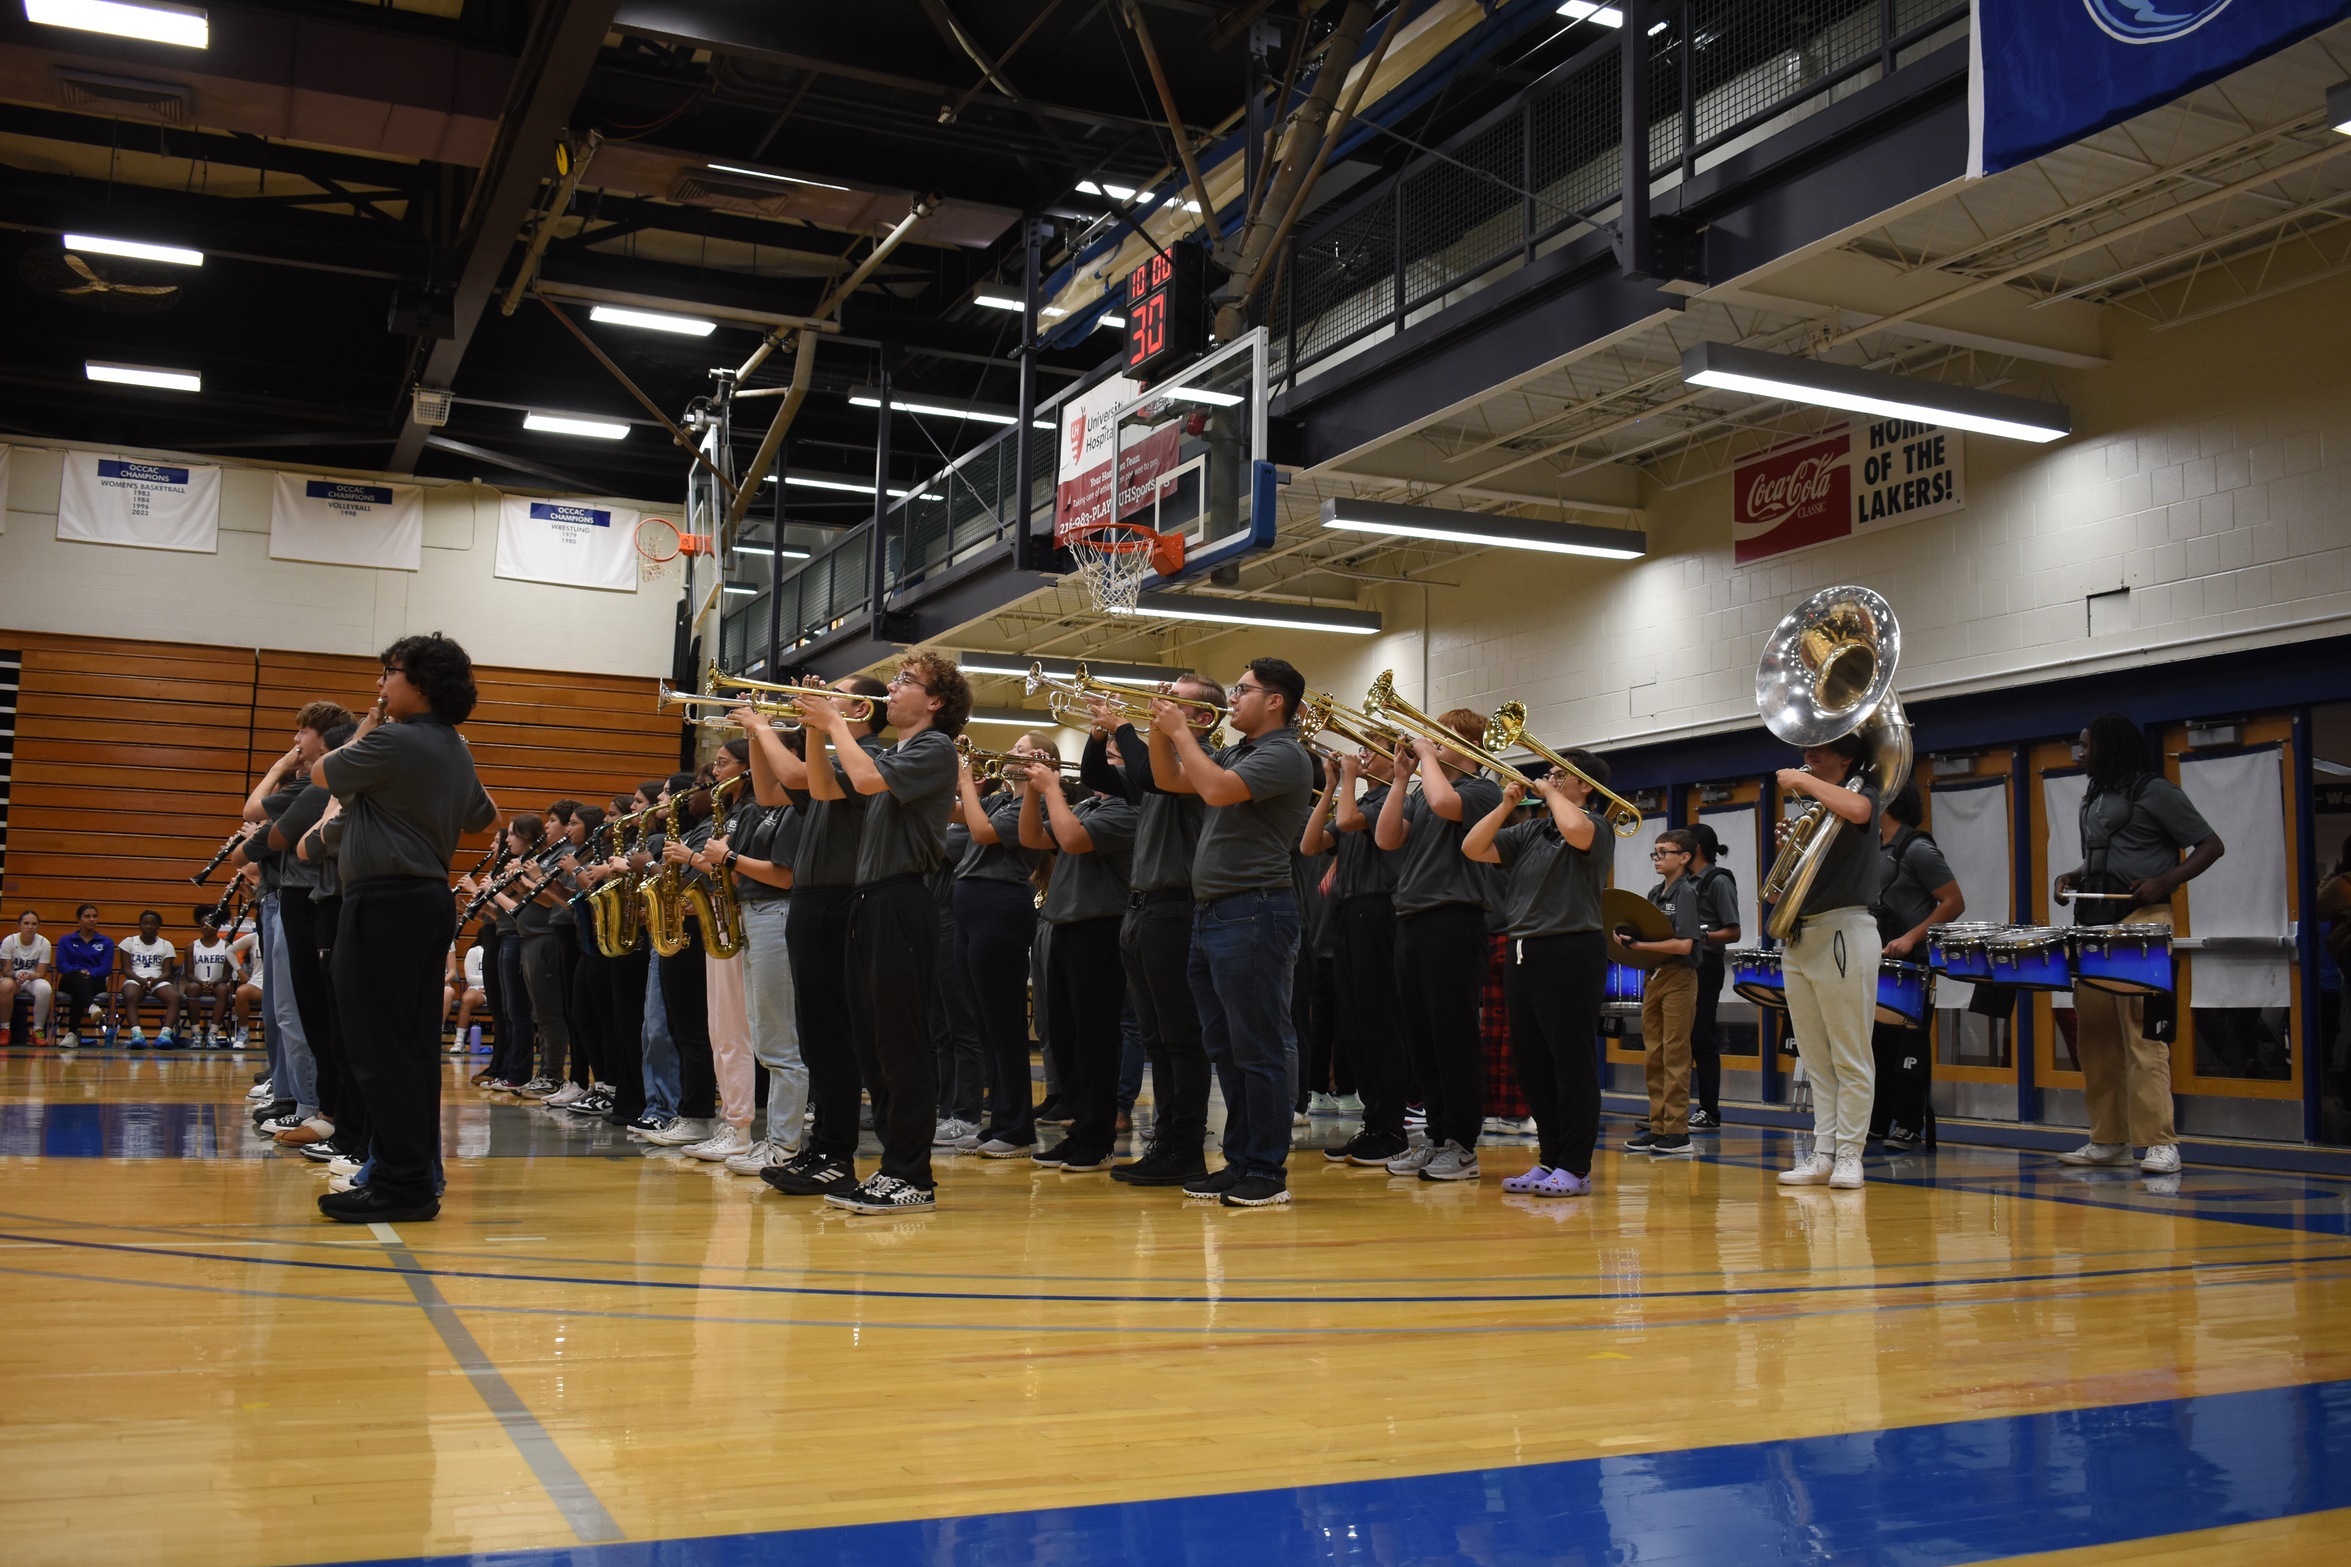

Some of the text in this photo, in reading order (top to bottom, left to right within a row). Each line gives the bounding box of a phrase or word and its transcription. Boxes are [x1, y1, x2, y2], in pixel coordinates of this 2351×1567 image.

[1130, 293, 1165, 366] 30
[1087, 400, 1123, 432] Universit
[1086, 427, 1114, 453] Hospita
[1143, 462, 1150, 471] to
[1863, 435, 1946, 486] OF THE
[129, 464, 159, 474] OCCAC
[1090, 476, 1102, 488] Your
[1126, 455, 1140, 467] Team
[120, 470, 170, 482] CHAMPIONS
[101, 480, 185, 493] WOMEN'S BASKETBALL
[336, 485, 365, 494] OCCAC
[1746, 451, 1836, 518] Coca-Cola
[328, 491, 375, 502] CHAMPIONS
[1858, 469, 1953, 524] LAKERS!
[328, 502, 371, 512] VOLLEYBALL
[558, 507, 585, 516] OCCAC
[1797, 501, 1827, 519] CLASSIC
[550, 513, 594, 523] CHAMPIONS
[551, 524, 590, 533] WRESTLING
[131, 953, 163, 965] LAKERS
[194, 954, 225, 965] LAKERS
[206, 966, 210, 978] 1
